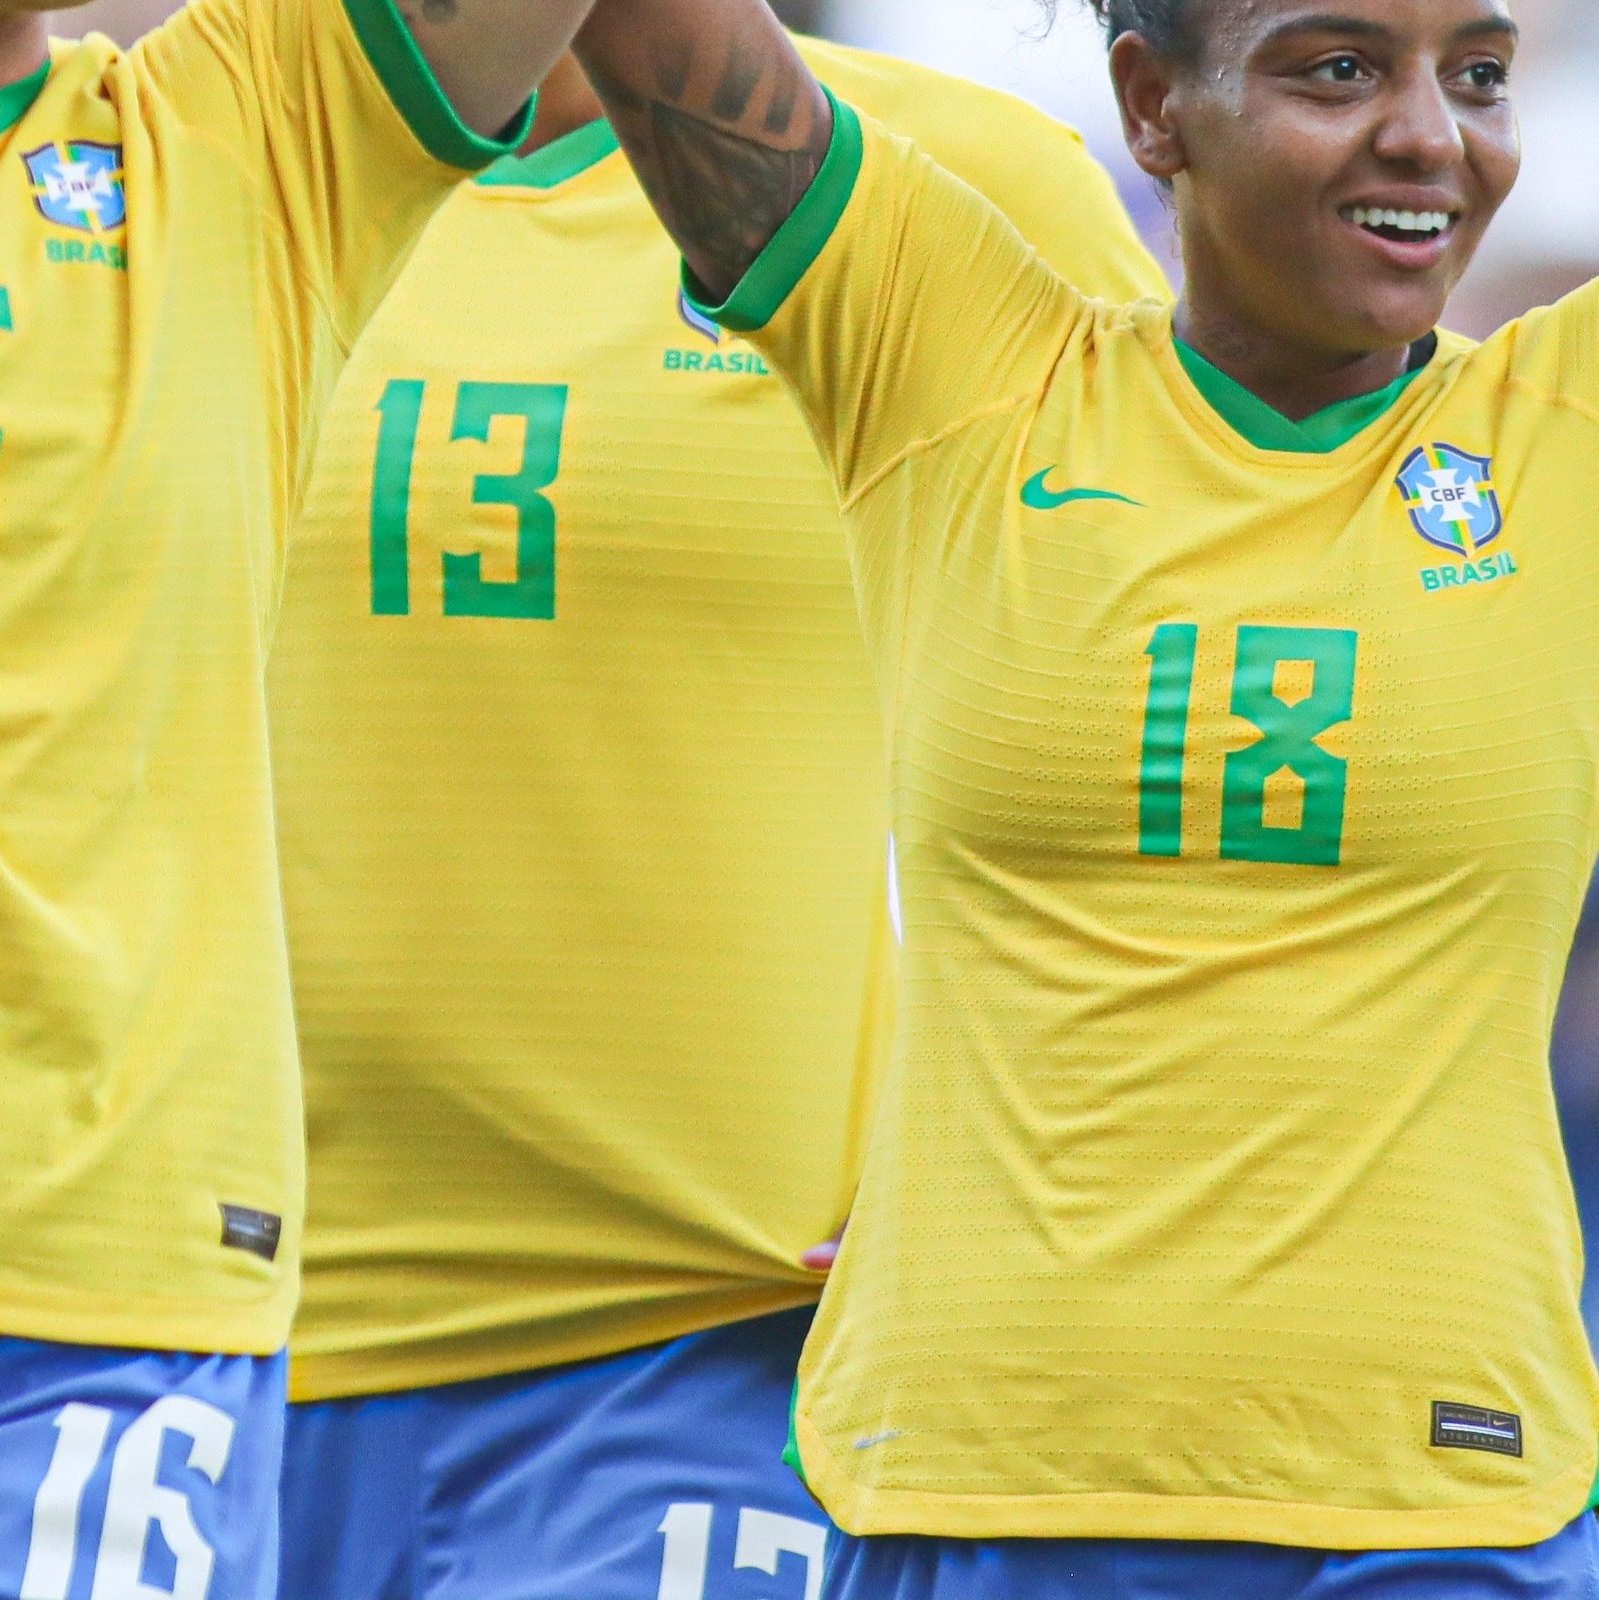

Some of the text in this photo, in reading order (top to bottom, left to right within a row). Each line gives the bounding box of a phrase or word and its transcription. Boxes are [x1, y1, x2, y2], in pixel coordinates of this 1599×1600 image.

[664, 349, 769, 376] BRASIL
[370, 379, 569, 619] 13
[1430, 487, 1466, 502] CBF
[1419, 553, 1517, 592] BRASIL
[1138, 623, 1357, 866] 18
[18, 1396, 235, 1600] 16
